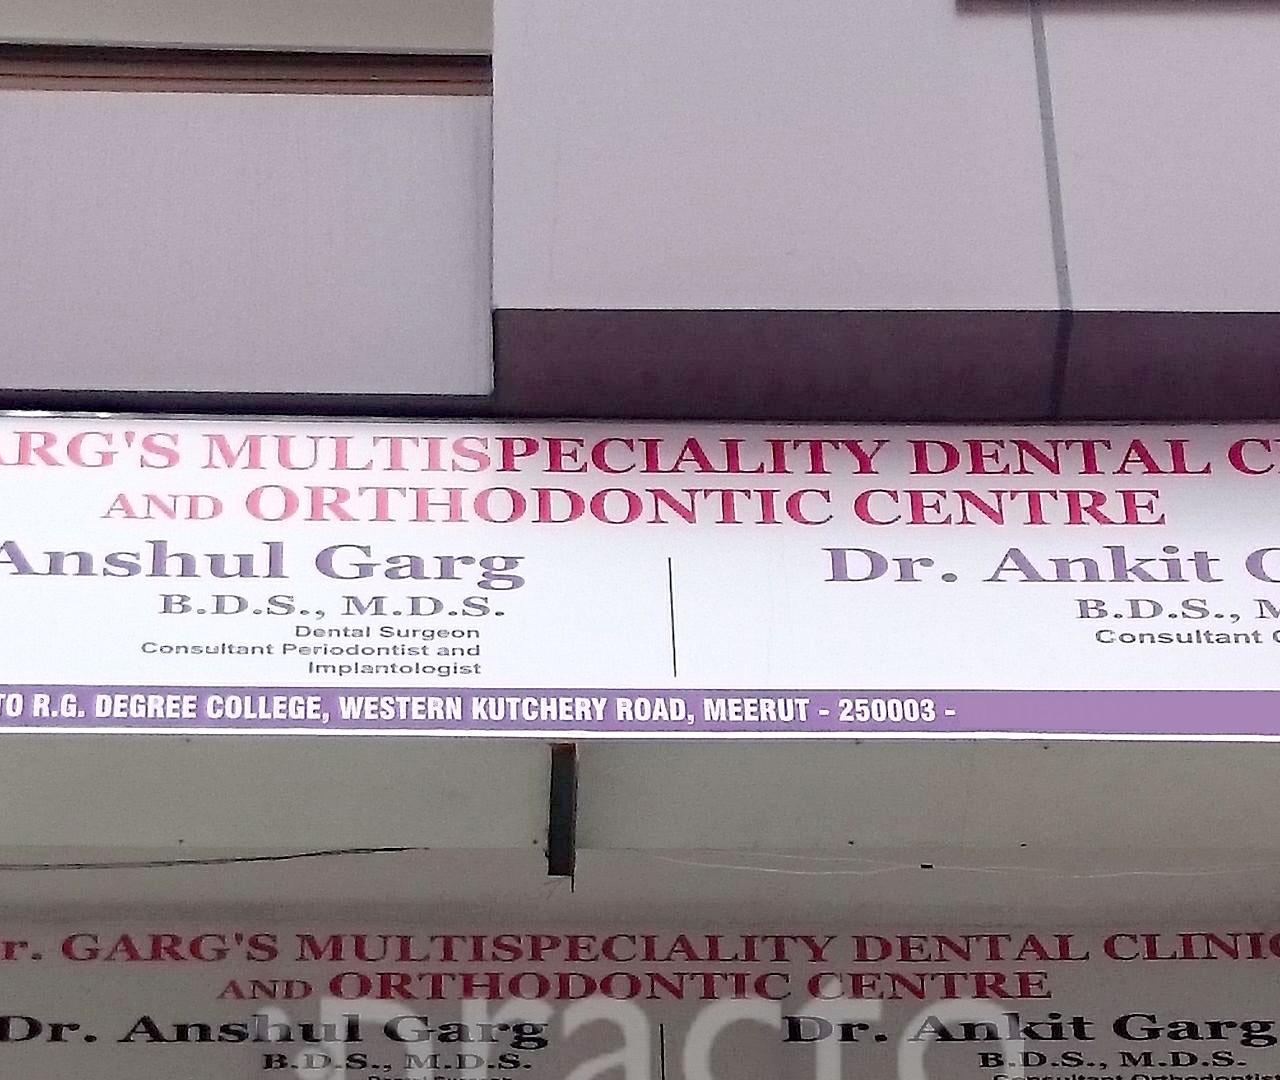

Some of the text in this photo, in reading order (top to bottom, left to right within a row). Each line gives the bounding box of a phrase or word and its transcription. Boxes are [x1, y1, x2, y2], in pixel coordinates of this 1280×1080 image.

[202, 433, 890, 475] MULTISPECIALITY
[910, 438, 1211, 476] DENTAL
[100, 484, 1166, 526] AND ORTHODONTIC CENTRE
[315, 543, 526, 591] Garg
[821, 546, 958, 584] Dr.
[983, 545, 1223, 584] Ankit
[158, 593, 506, 619] B.D.S., M.D.S.
[1076, 599, 1241, 624] B.D.S.,
[295, 624, 480, 642] Dental Surgeon
[1095, 629, 1263, 645] Consultant
[141, 642, 481, 658] Consultant Periodontist and
[308, 661, 482, 679] Implantologist
[32, 694, 86, 718] R.G.
[95, 695, 197, 719] DEGREE
[206, 696, 330, 724] COLLEGE,
[339, 697, 462, 721] WESTERN
[472, 697, 607, 722] KUTCHERY
[618, 698, 696, 725] ROAD,
[704, 698, 810, 722] MEERUT
[838, 698, 937, 722] 250003
[61, 933, 278, 962] GARG'S
[296, 934, 836, 962] MULTISPECIALITY
[852, 934, 1090, 962] DENTAL
[217, 972, 1052, 1001] AND ORTHODONTIC CENTRE
[117, 1014, 363, 1043] Anshul
[383, 1015, 550, 1050] Garg
[782, 1012, 1278, 1048] Dr. Ankit Garg
[262, 1053, 532, 1074] B.D.S., M.D.S.
[979, 1051, 1247, 1071] B.D.S., M.D.S.
